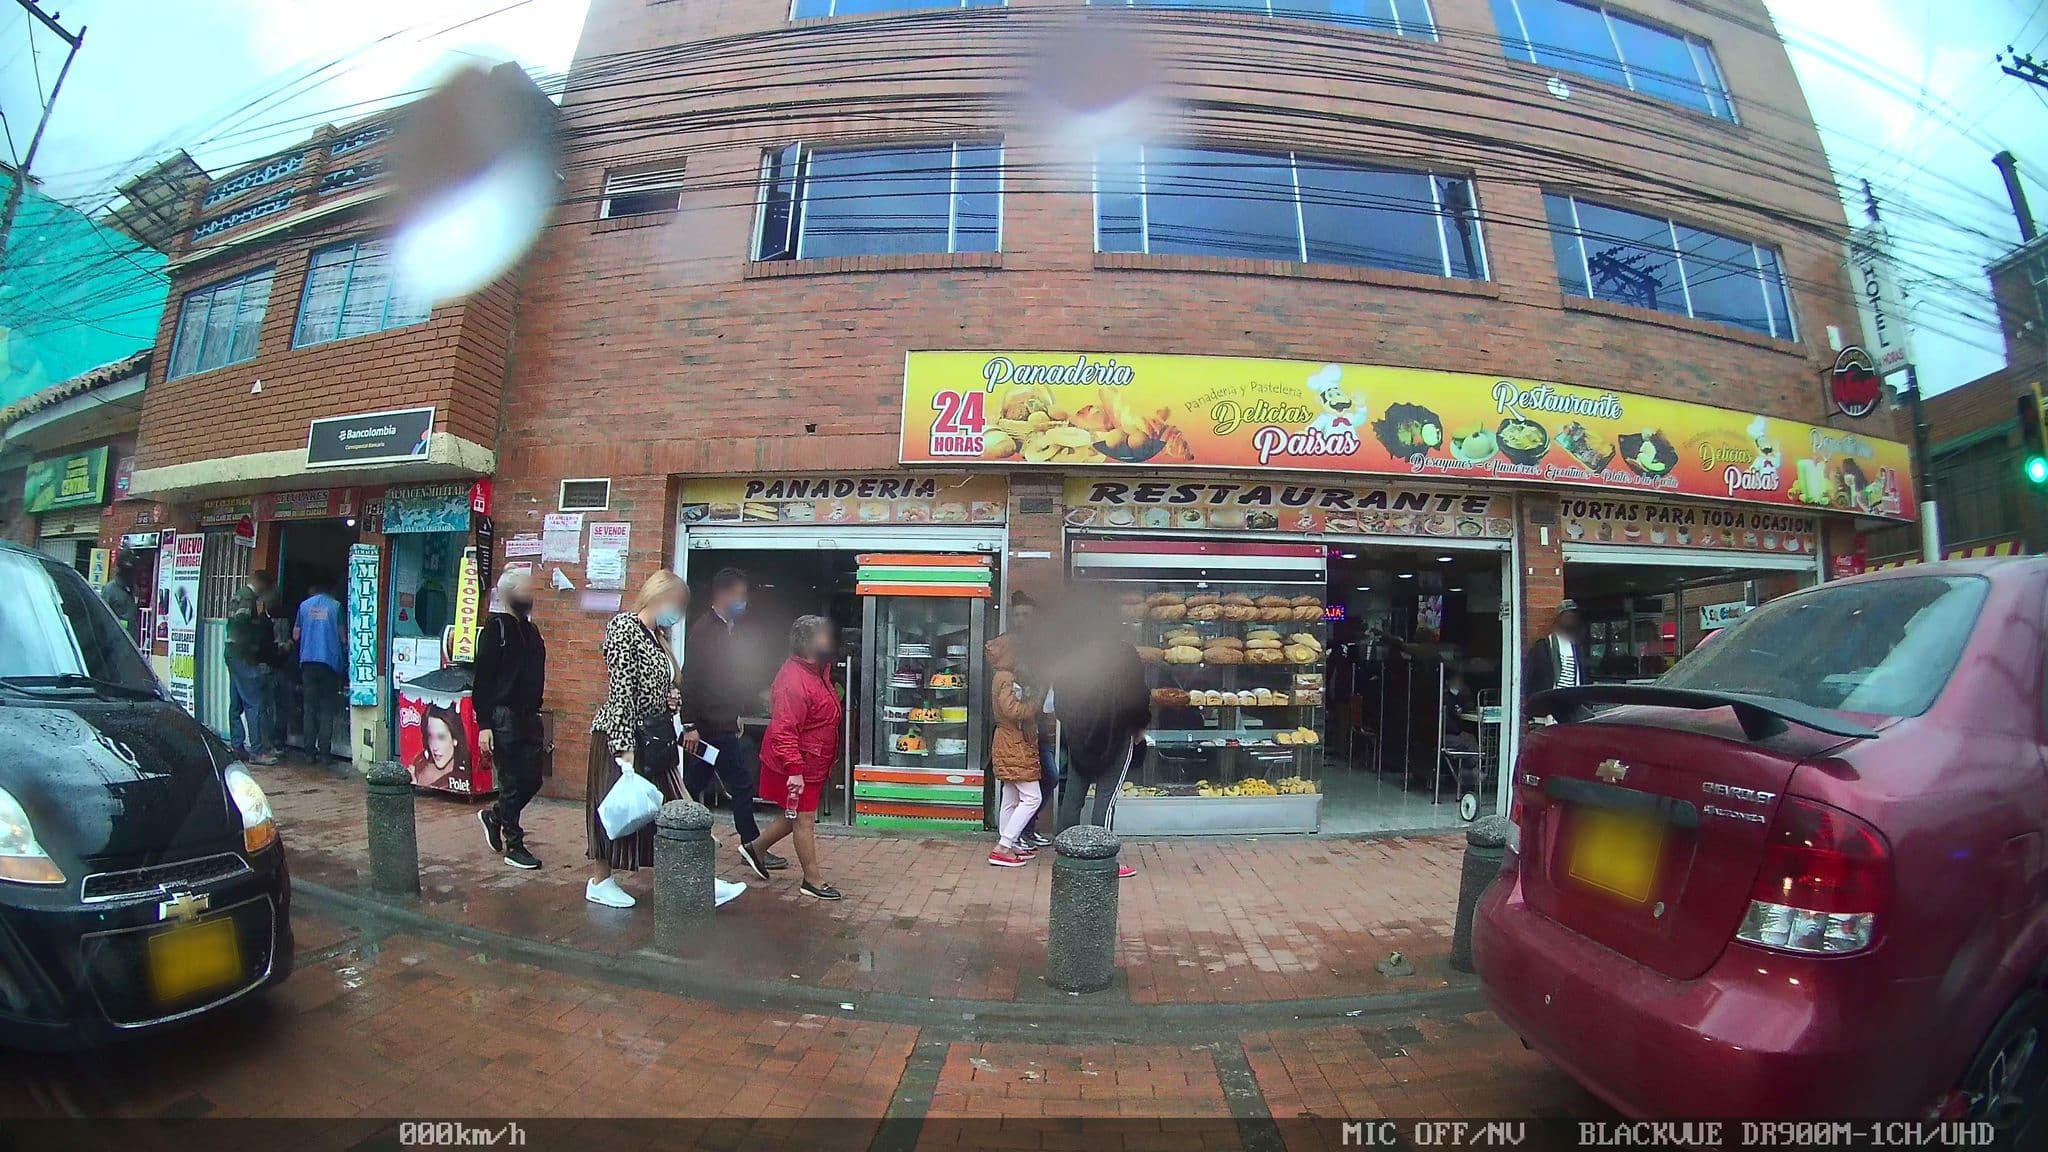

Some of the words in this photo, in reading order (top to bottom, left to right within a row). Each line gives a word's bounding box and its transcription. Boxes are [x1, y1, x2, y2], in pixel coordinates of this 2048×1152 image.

[983, 355, 1135, 393] Panaderia
[932, 391, 986, 435] 24
[1492, 380, 1623, 421] Restaurante
[347, 425, 396, 439] Bancolombia
[1211, 399, 1313, 436] Delicias
[934, 436, 985, 453] HORAS
[1253, 425, 1360, 465] Paisas
[1699, 441, 1753, 472] Delicias
[1410, 453, 1473, 473] Desayunos
[744, 478, 936, 499] PANADERIA
[1723, 464, 1780, 497] Paisas
[1090, 482, 1491, 514] RESTAURANTE
[594, 527, 603, 536] SE
[604, 527, 627, 536] VENDE
[1561, 500, 1640, 520] TORTAS
[1645, 506, 1695, 525] PARA
[1702, 510, 1745, 528] TODA
[1751, 513, 1813, 533] OCASION
[178, 537, 203, 554] NUEVO
[458, 558, 478, 653] FOTOCOPIAS
[357, 563, 377, 681] MILITAR
[449, 777, 470, 792] Polet
